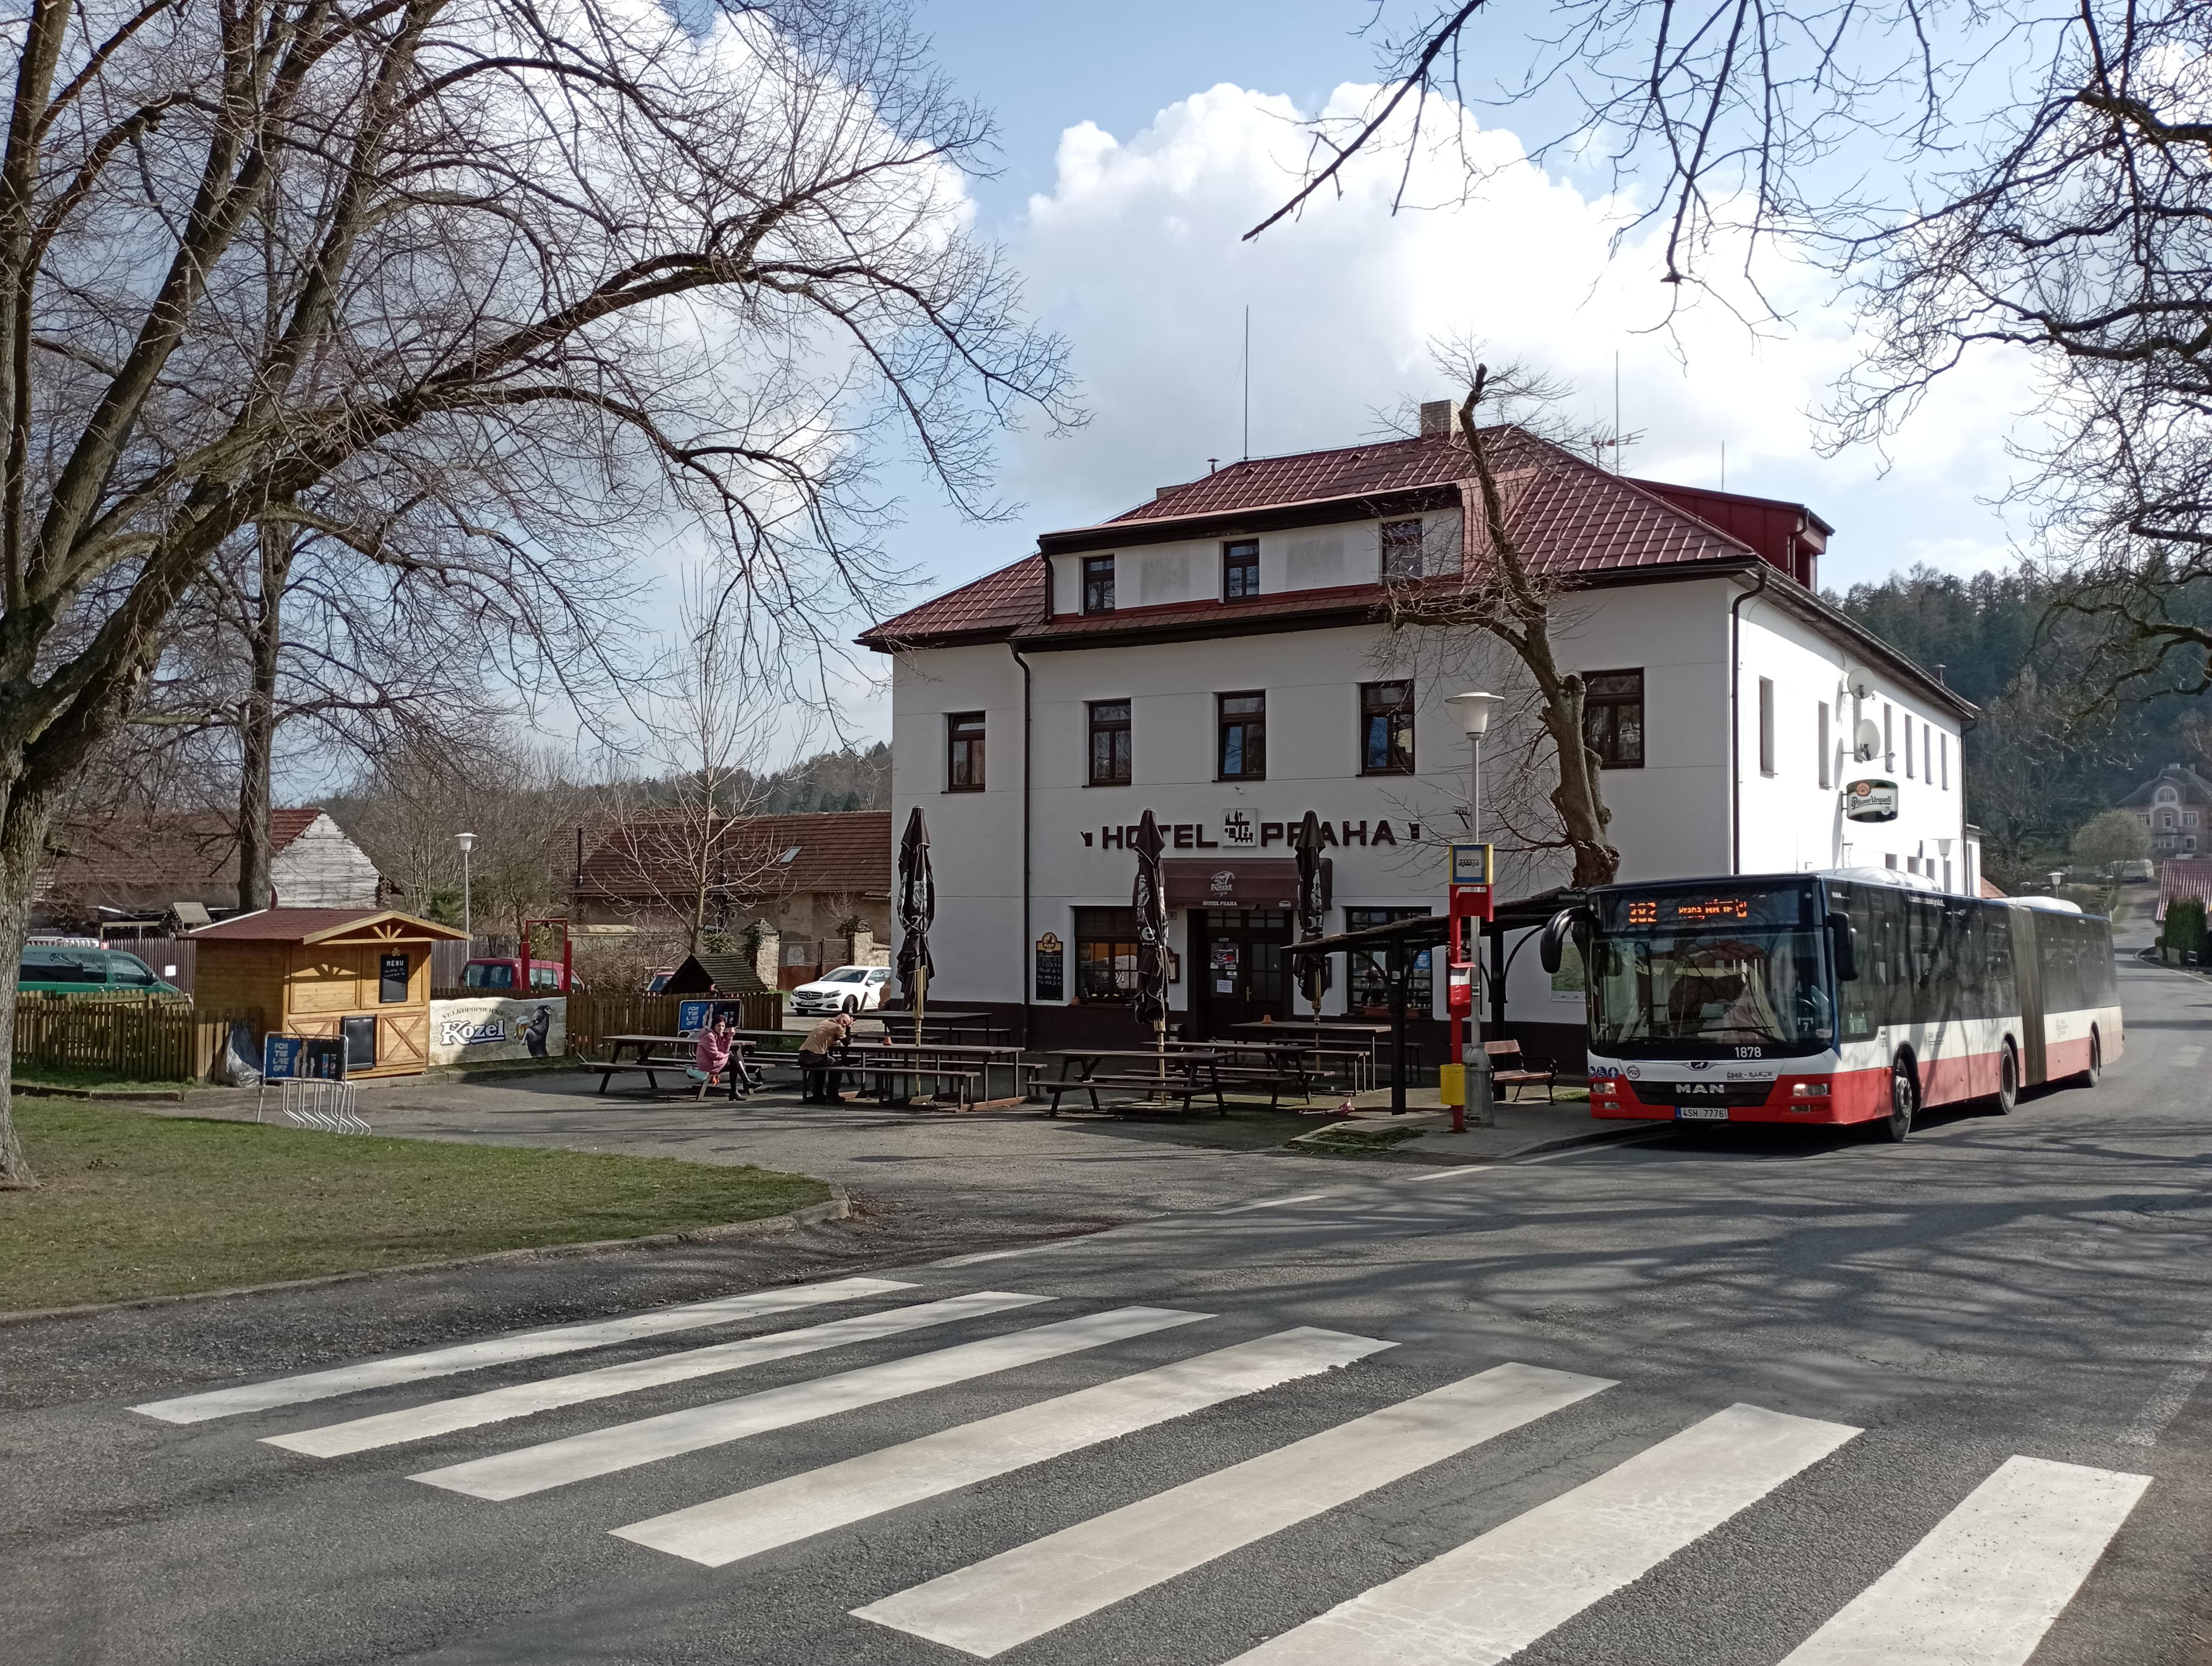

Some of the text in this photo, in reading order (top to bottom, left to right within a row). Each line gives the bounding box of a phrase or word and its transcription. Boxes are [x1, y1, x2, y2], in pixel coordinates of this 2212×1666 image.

[1851, 795, 1891, 810] Pilsner Urquell
[1261, 820, 1396, 846] PRAHA
[440, 1018, 506, 1046] Kozel
[1735, 1047, 1762, 1058] 1878
[1676, 1084, 1725, 1093] MAN
[1683, 1108, 1724, 1118] 4SH 7776
